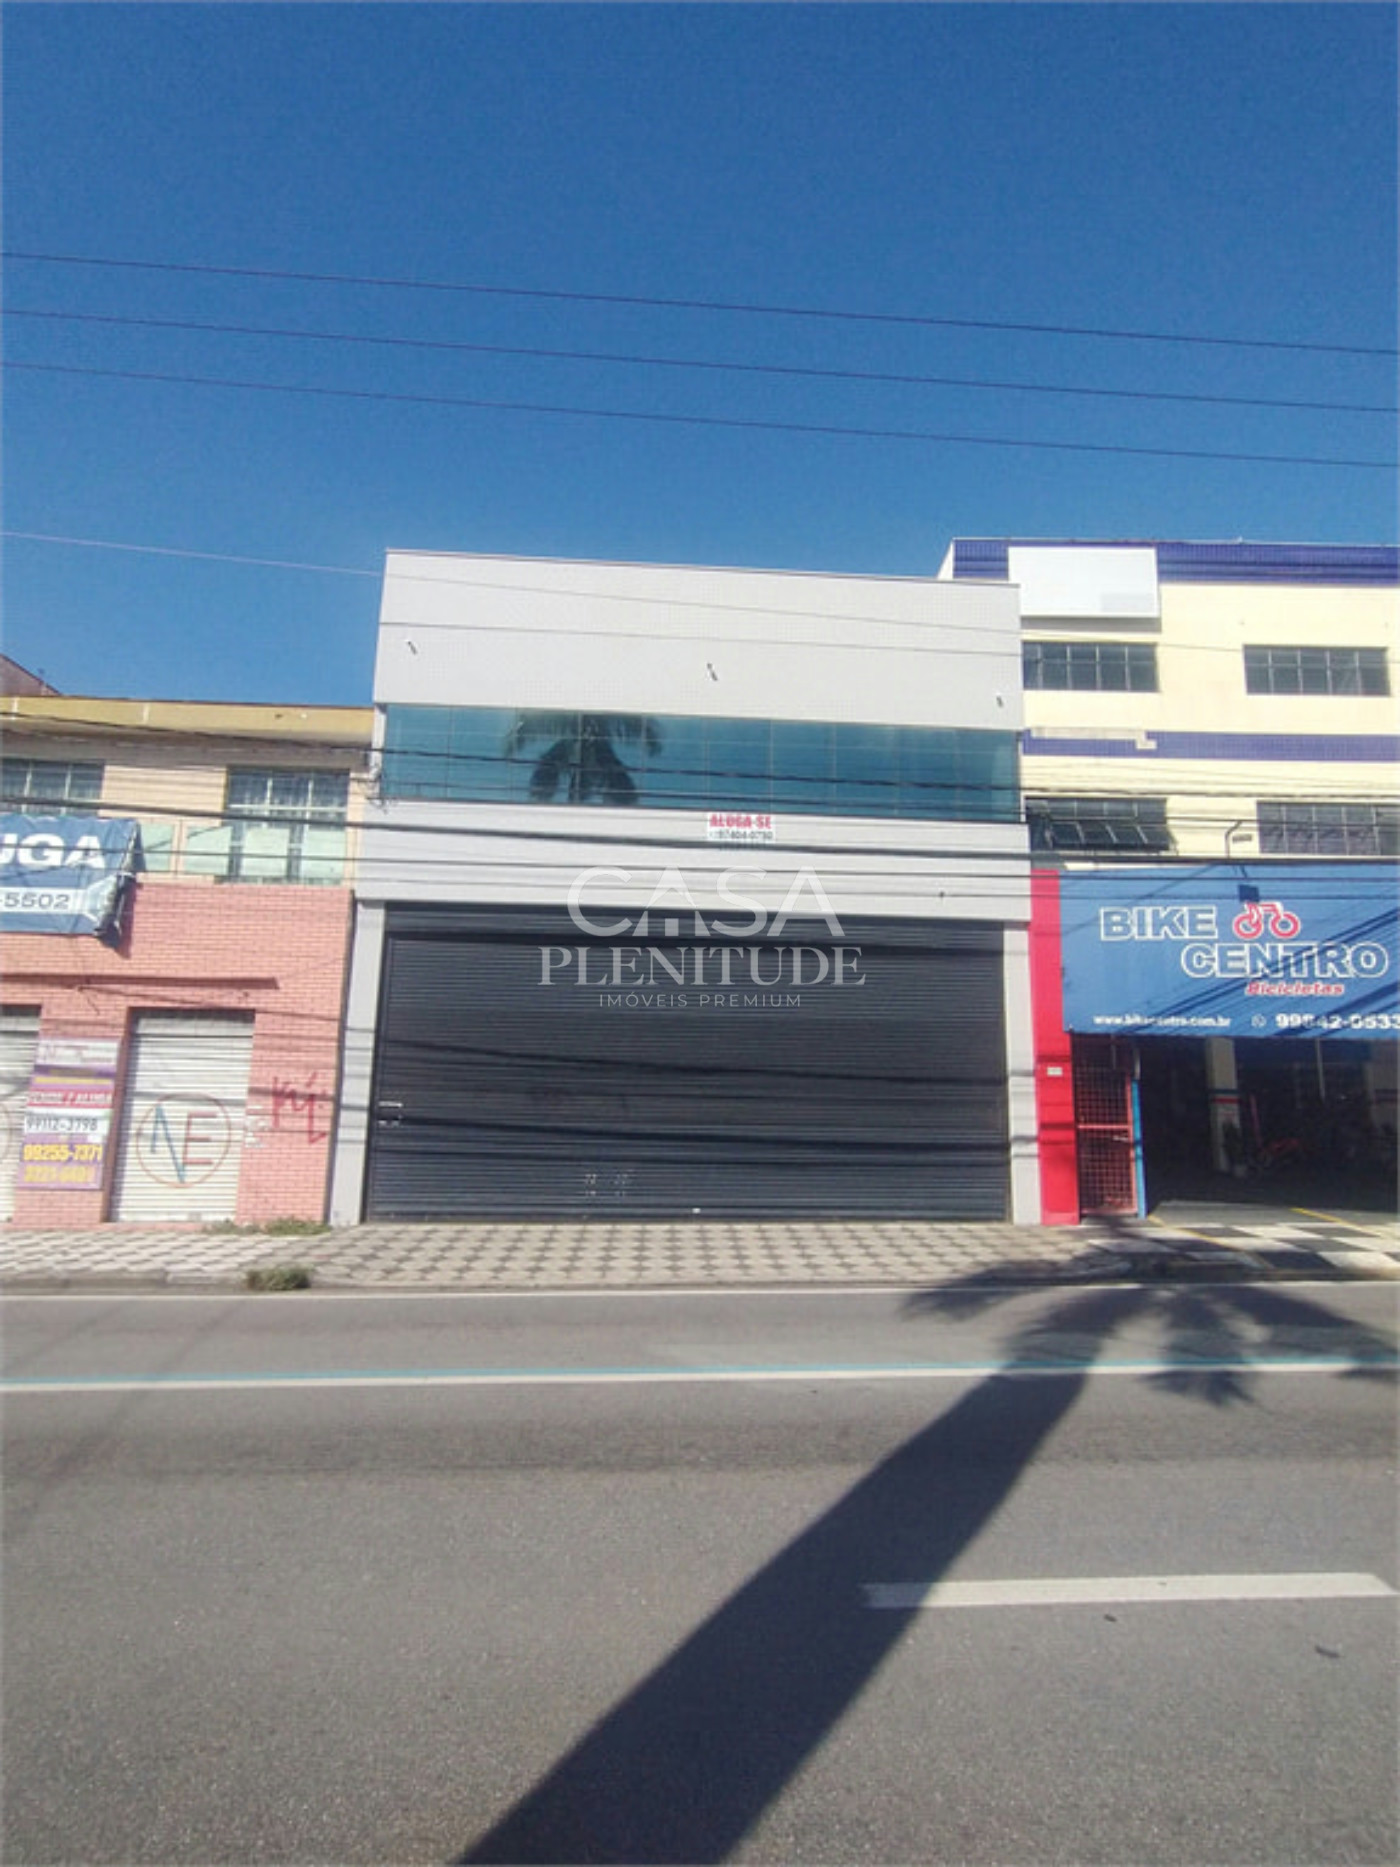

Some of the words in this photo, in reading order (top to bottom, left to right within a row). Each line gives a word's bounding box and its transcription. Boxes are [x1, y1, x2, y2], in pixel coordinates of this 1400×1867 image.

[709, 813, 772, 829] ALUGA-SE
[1100, 905, 1218, 941] BIKE
[1181, 942, 1389, 978] CENTRO
[1246, 981, 1344, 996] Bicicletas
